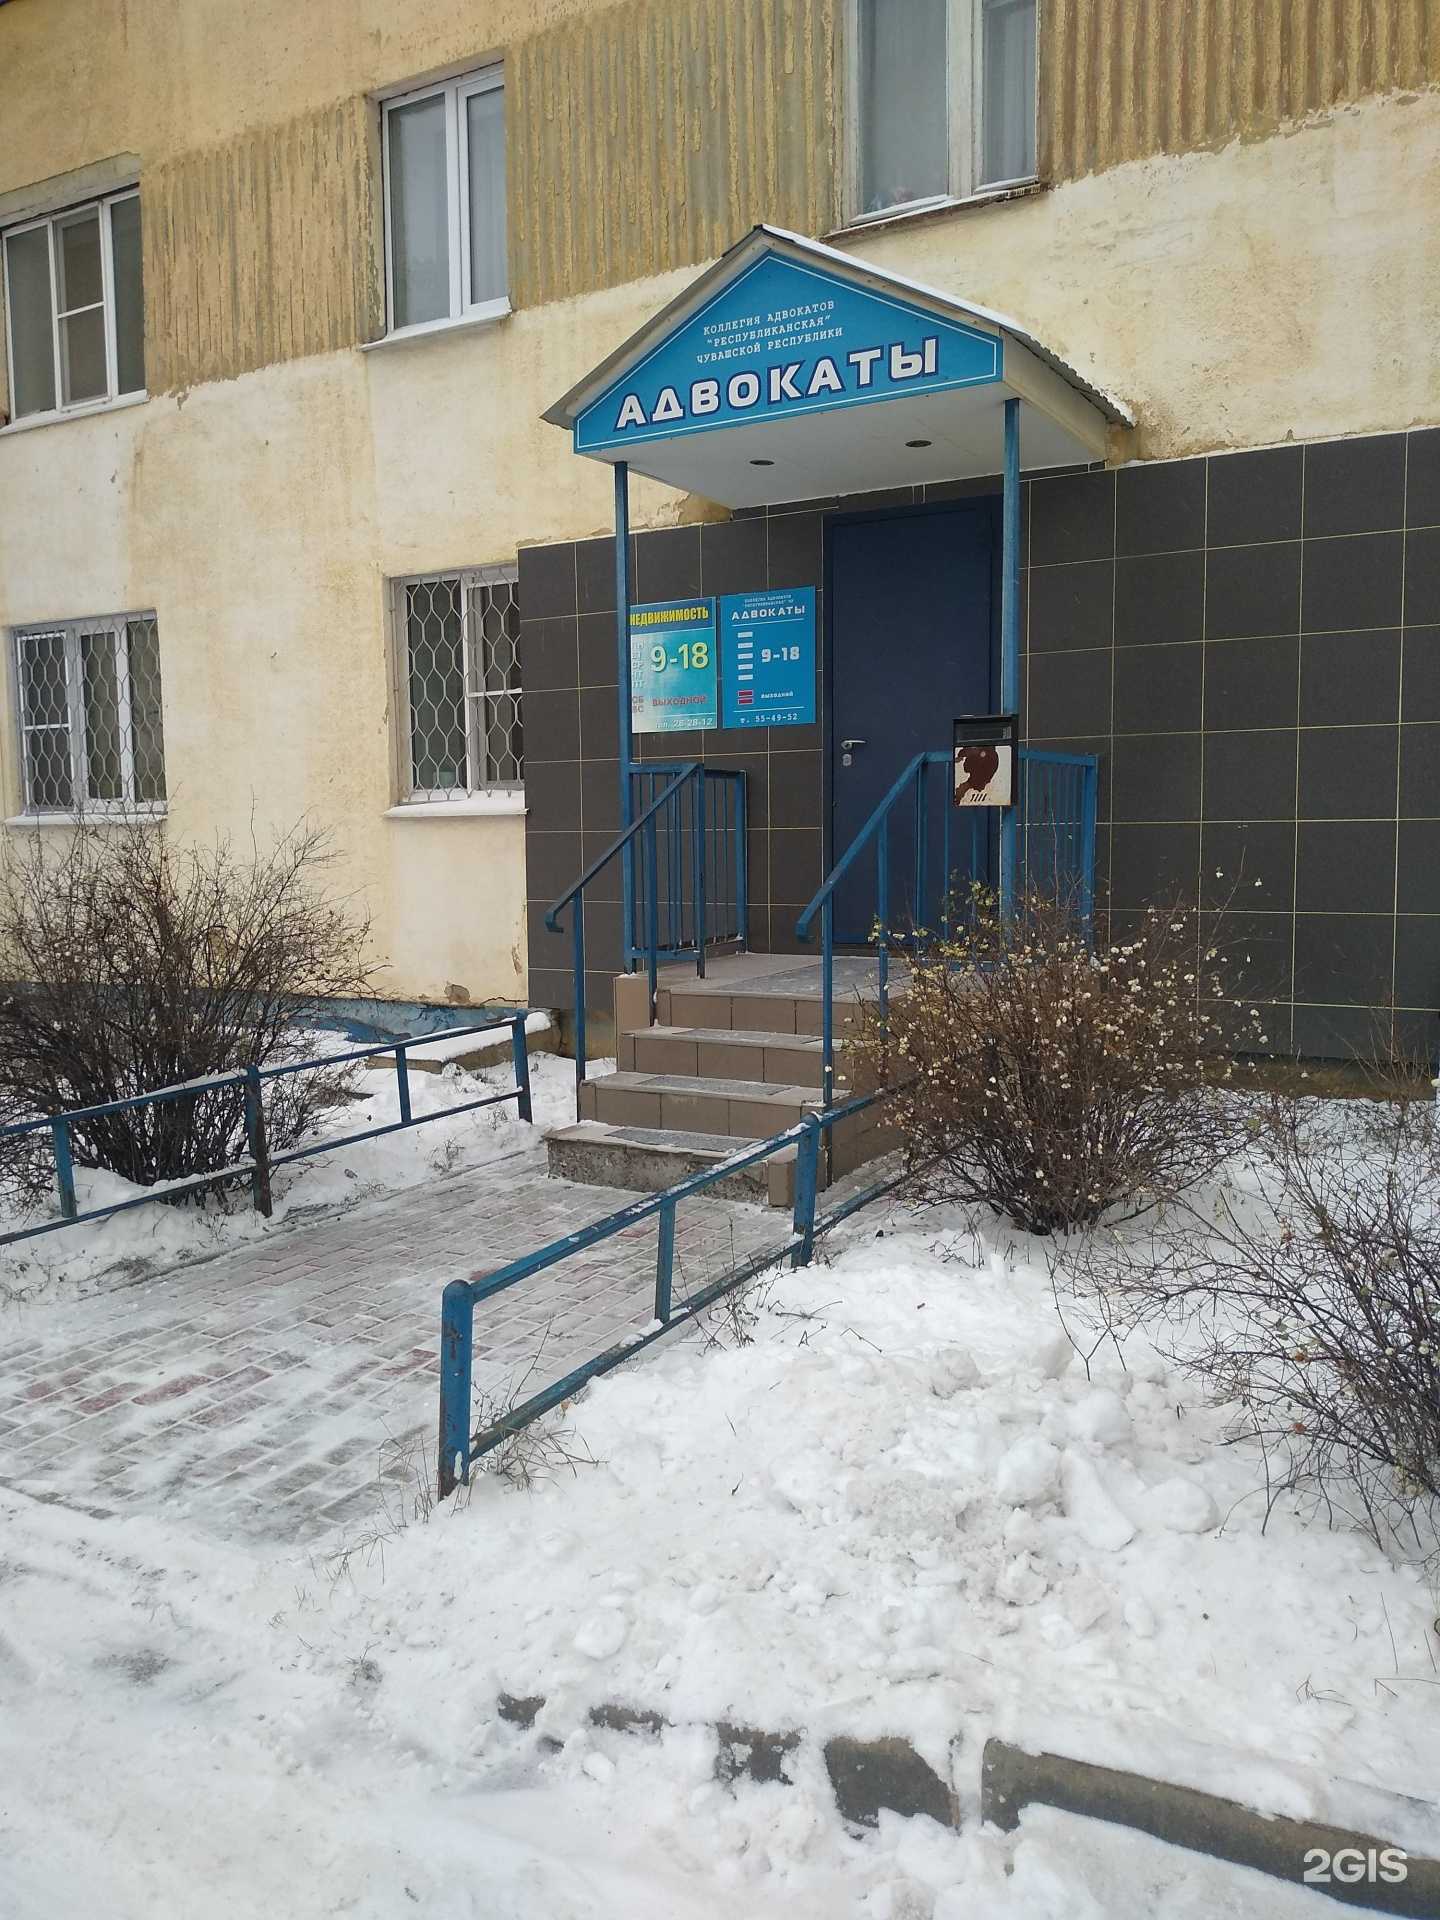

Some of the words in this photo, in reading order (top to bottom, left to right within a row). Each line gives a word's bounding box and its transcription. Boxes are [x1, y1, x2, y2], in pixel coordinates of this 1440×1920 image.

[703, 315, 760, 336] КОЛЛЕГИЯ
[767, 300, 835, 323] АДВОКАТОВ
[696, 342, 761, 364] ЧУВАШСКОЙ
[767, 327, 843, 351] РЕСПУБЛИКИ
[613, 336, 940, 431] АДВОКАТЫ
[629, 606, 709, 627] НЕДВИЖИМОСТЬ
[731, 605, 806, 621] АДВОКАТЫ
[651, 641, 709, 672] 9-18
[761, 646, 800, 663] 9-18
